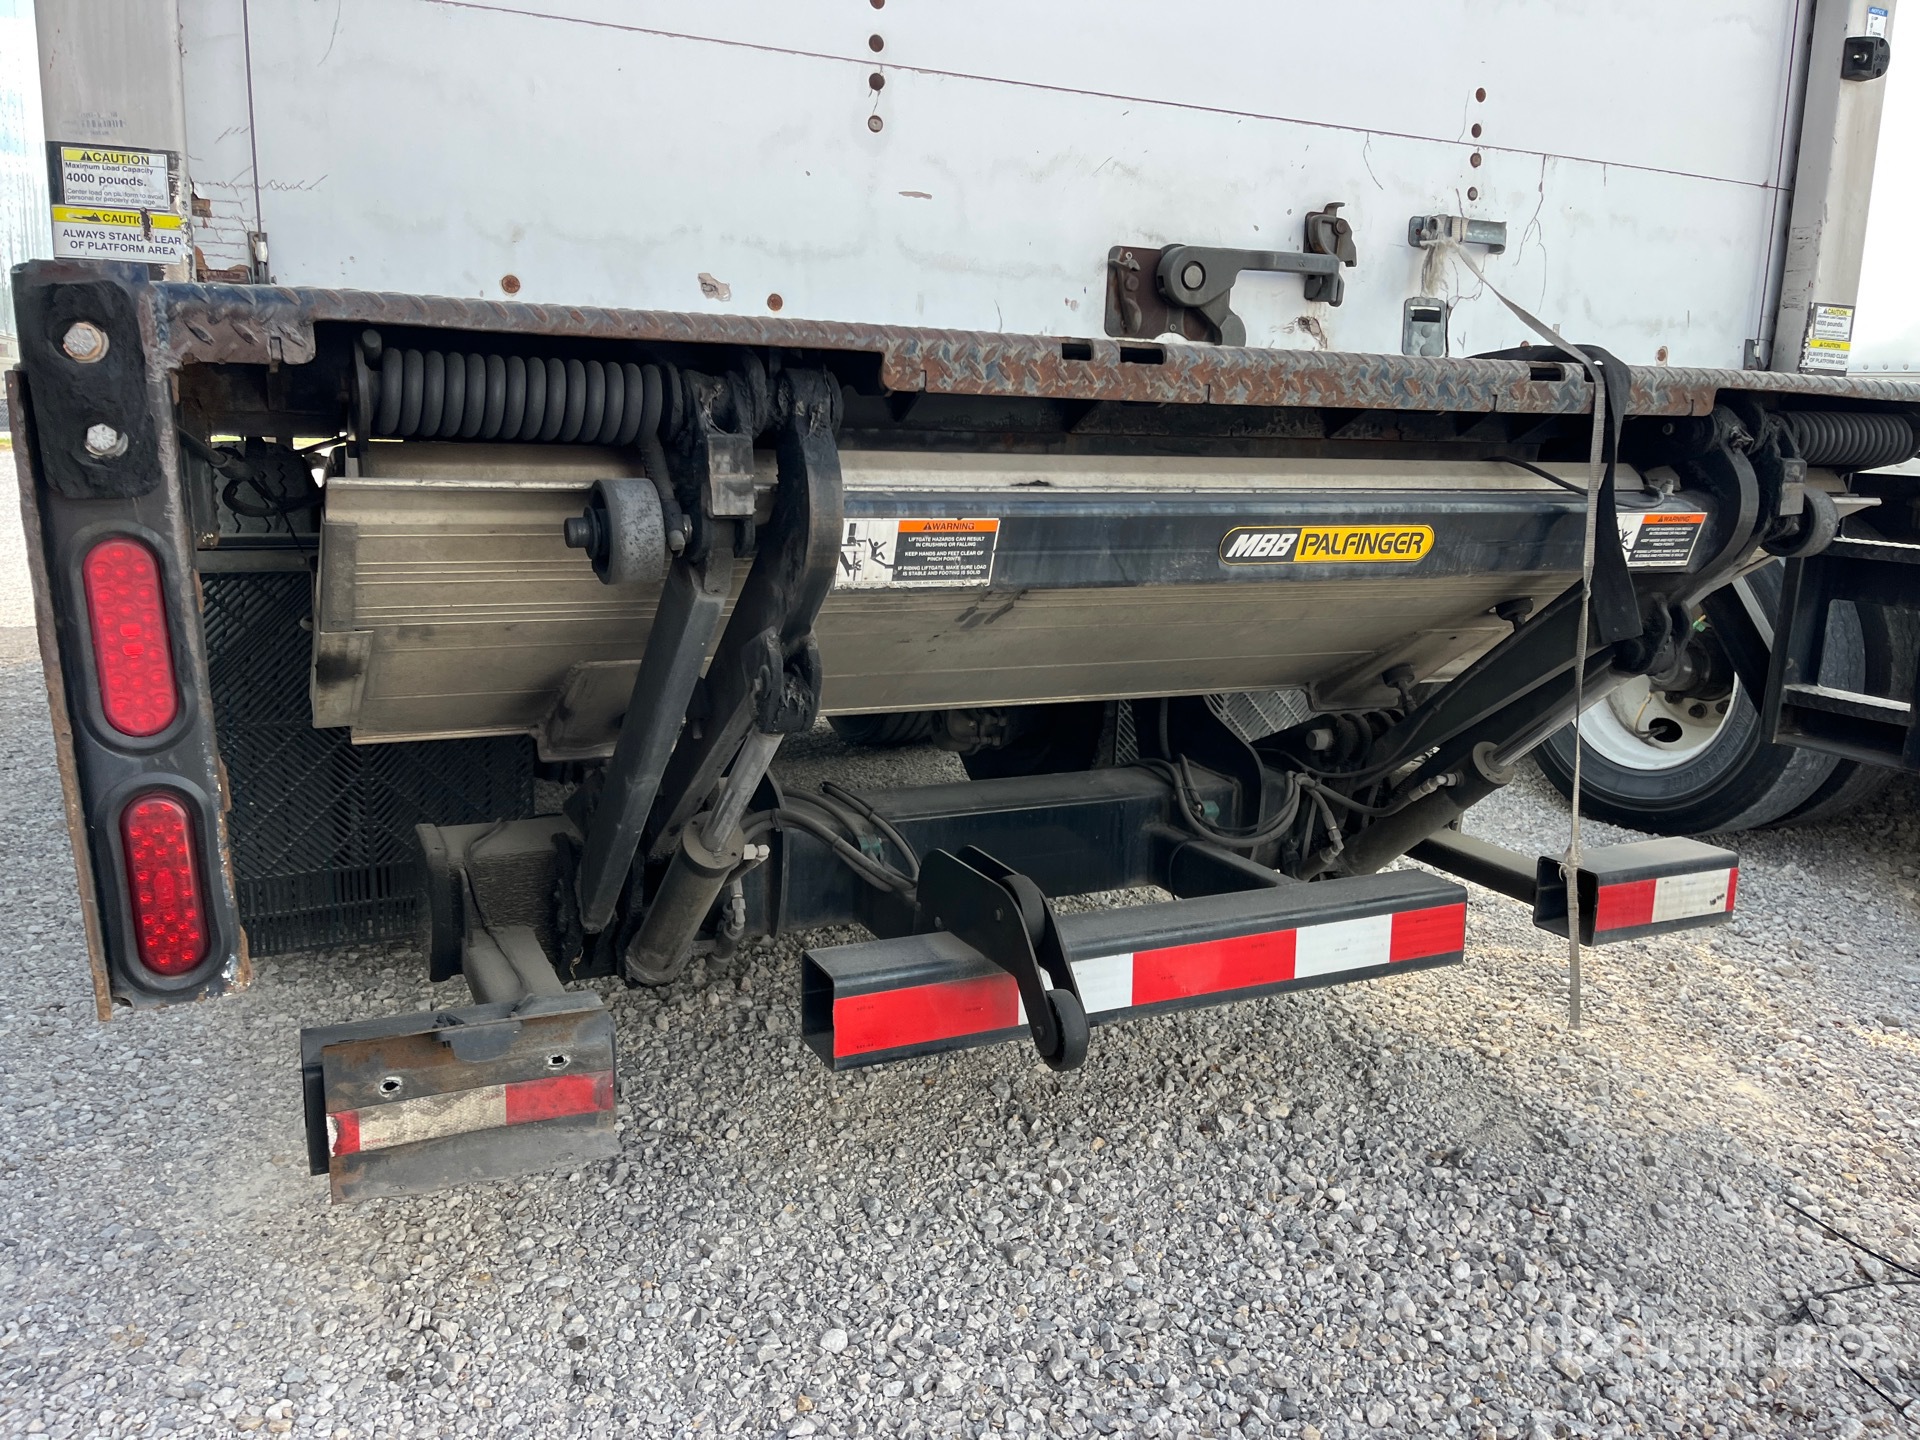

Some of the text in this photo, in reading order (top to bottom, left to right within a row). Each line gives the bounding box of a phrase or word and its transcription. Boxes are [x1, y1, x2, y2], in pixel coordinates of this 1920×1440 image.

[92, 152, 150, 165] CAUTION
[65, 162, 101, 170] Maximum
[122, 166, 153, 176] Capacity
[66, 173, 148, 186] 4000 pounds.
[104, 197, 129, 205] property
[148, 192, 164, 200] avoid
[63, 229, 182, 246] ALWAYS STAND LEAR
[70, 241, 177, 256] OF PLATFORM AREA
[932, 522, 975, 530] WARNING
[1226, 532, 1425, 558] MBB PALFINGER
